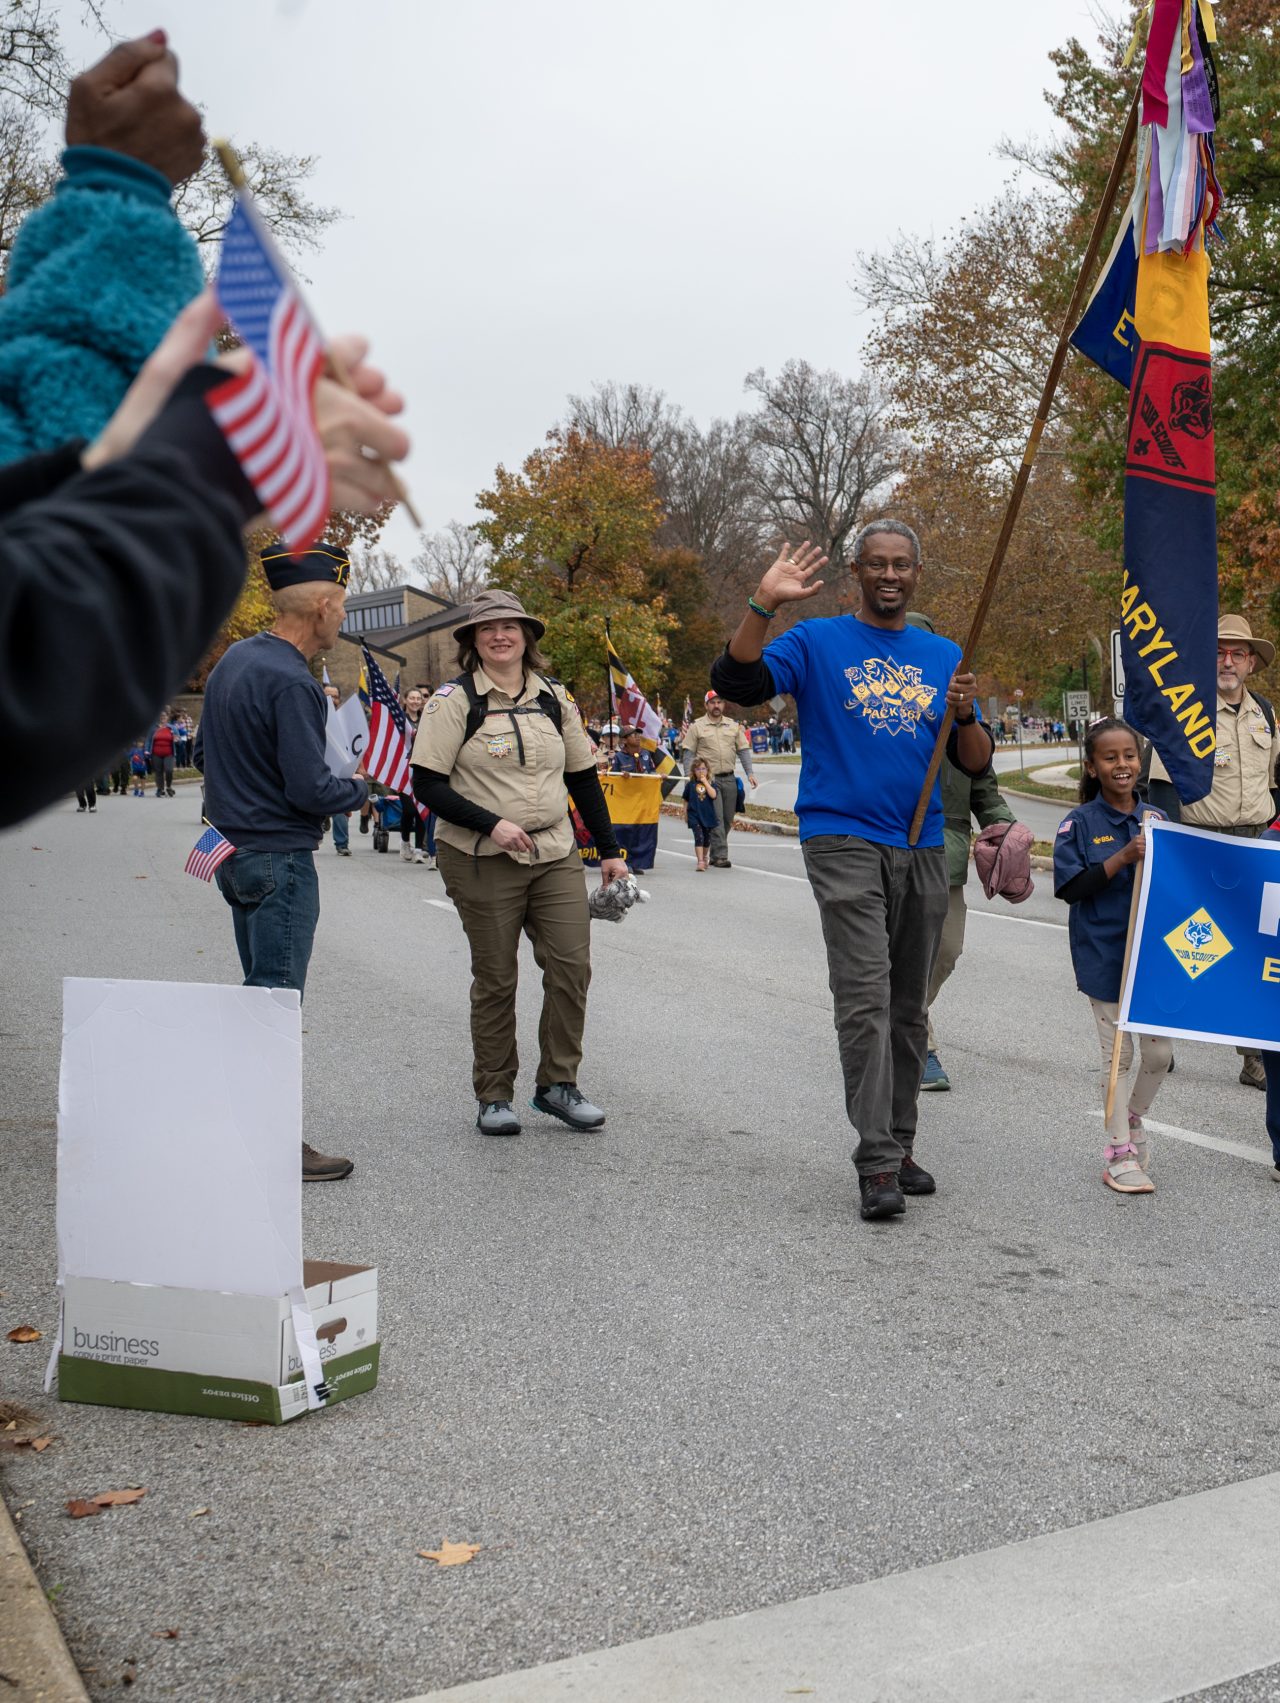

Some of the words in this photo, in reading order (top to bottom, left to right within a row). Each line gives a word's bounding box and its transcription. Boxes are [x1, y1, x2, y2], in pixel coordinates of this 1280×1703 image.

[1141, 393, 1159, 429] CUB
[1151, 420, 1187, 469] SCOUTS
[1121, 569, 1216, 759] ARYLAND
[863, 707, 899, 719] PACK
[1070, 706, 1088, 717] 35
[1175, 948, 1191, 960] CUB
[1191, 951, 1219, 963] SCOUTS
[73, 1326, 160, 1357] business
[101, 1353, 122, 1363] print
[123, 1355, 149, 1366] paper
[288, 1343, 337, 1371] buess
